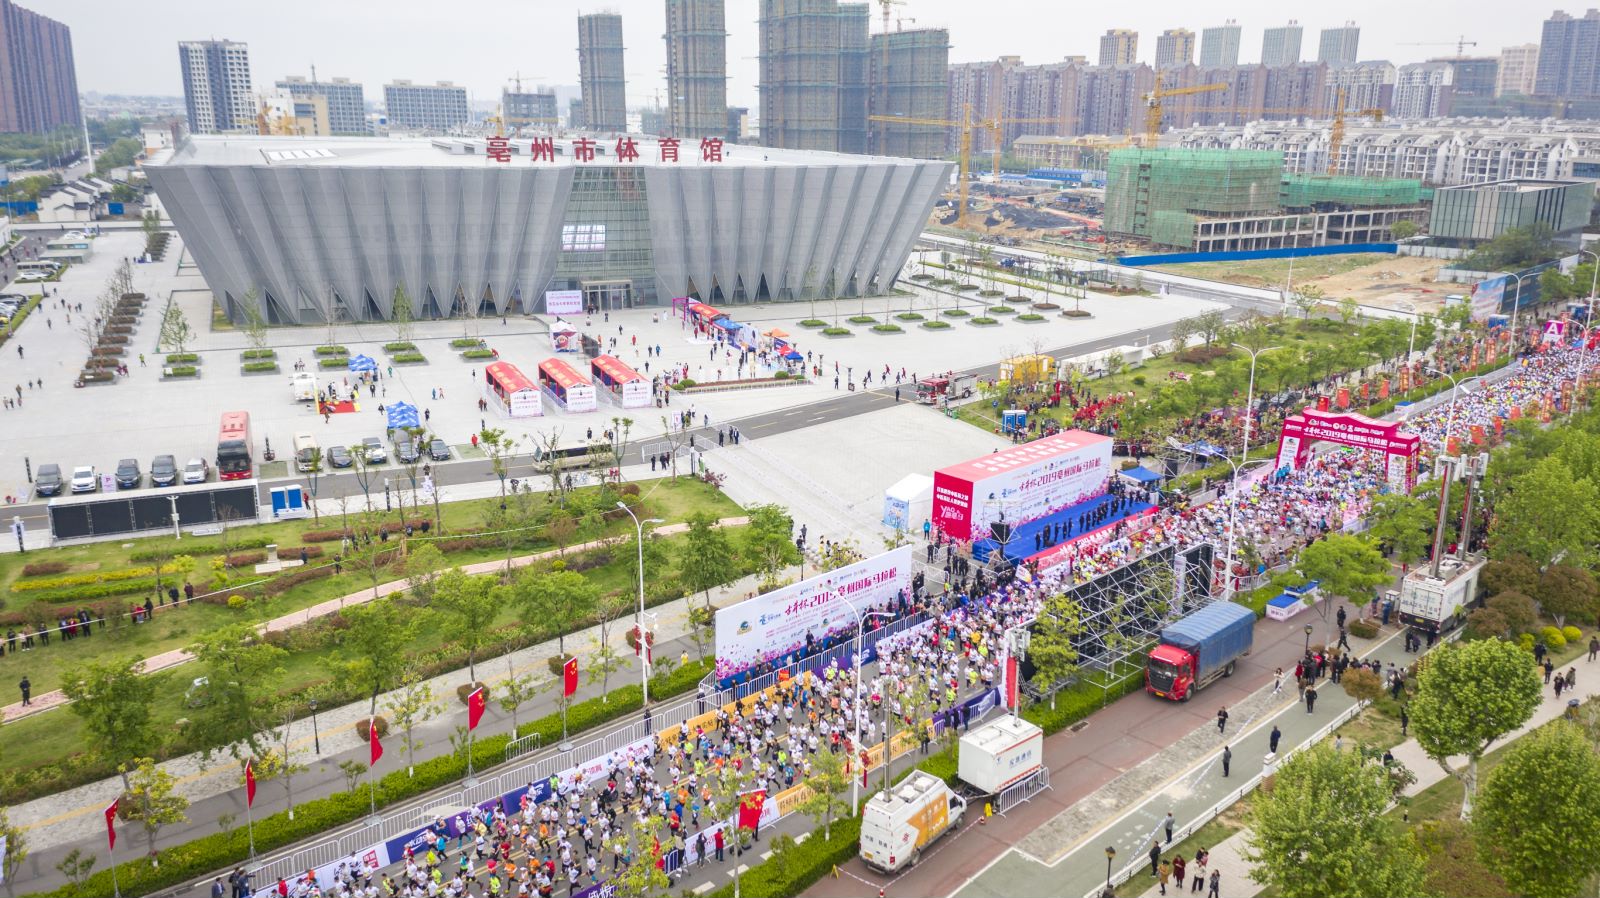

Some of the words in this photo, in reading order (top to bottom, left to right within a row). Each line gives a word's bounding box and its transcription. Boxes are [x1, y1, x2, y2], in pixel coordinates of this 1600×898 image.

[486, 136, 724, 163] 亳州市体育馆
[1546, 323, 1559, 335] A
